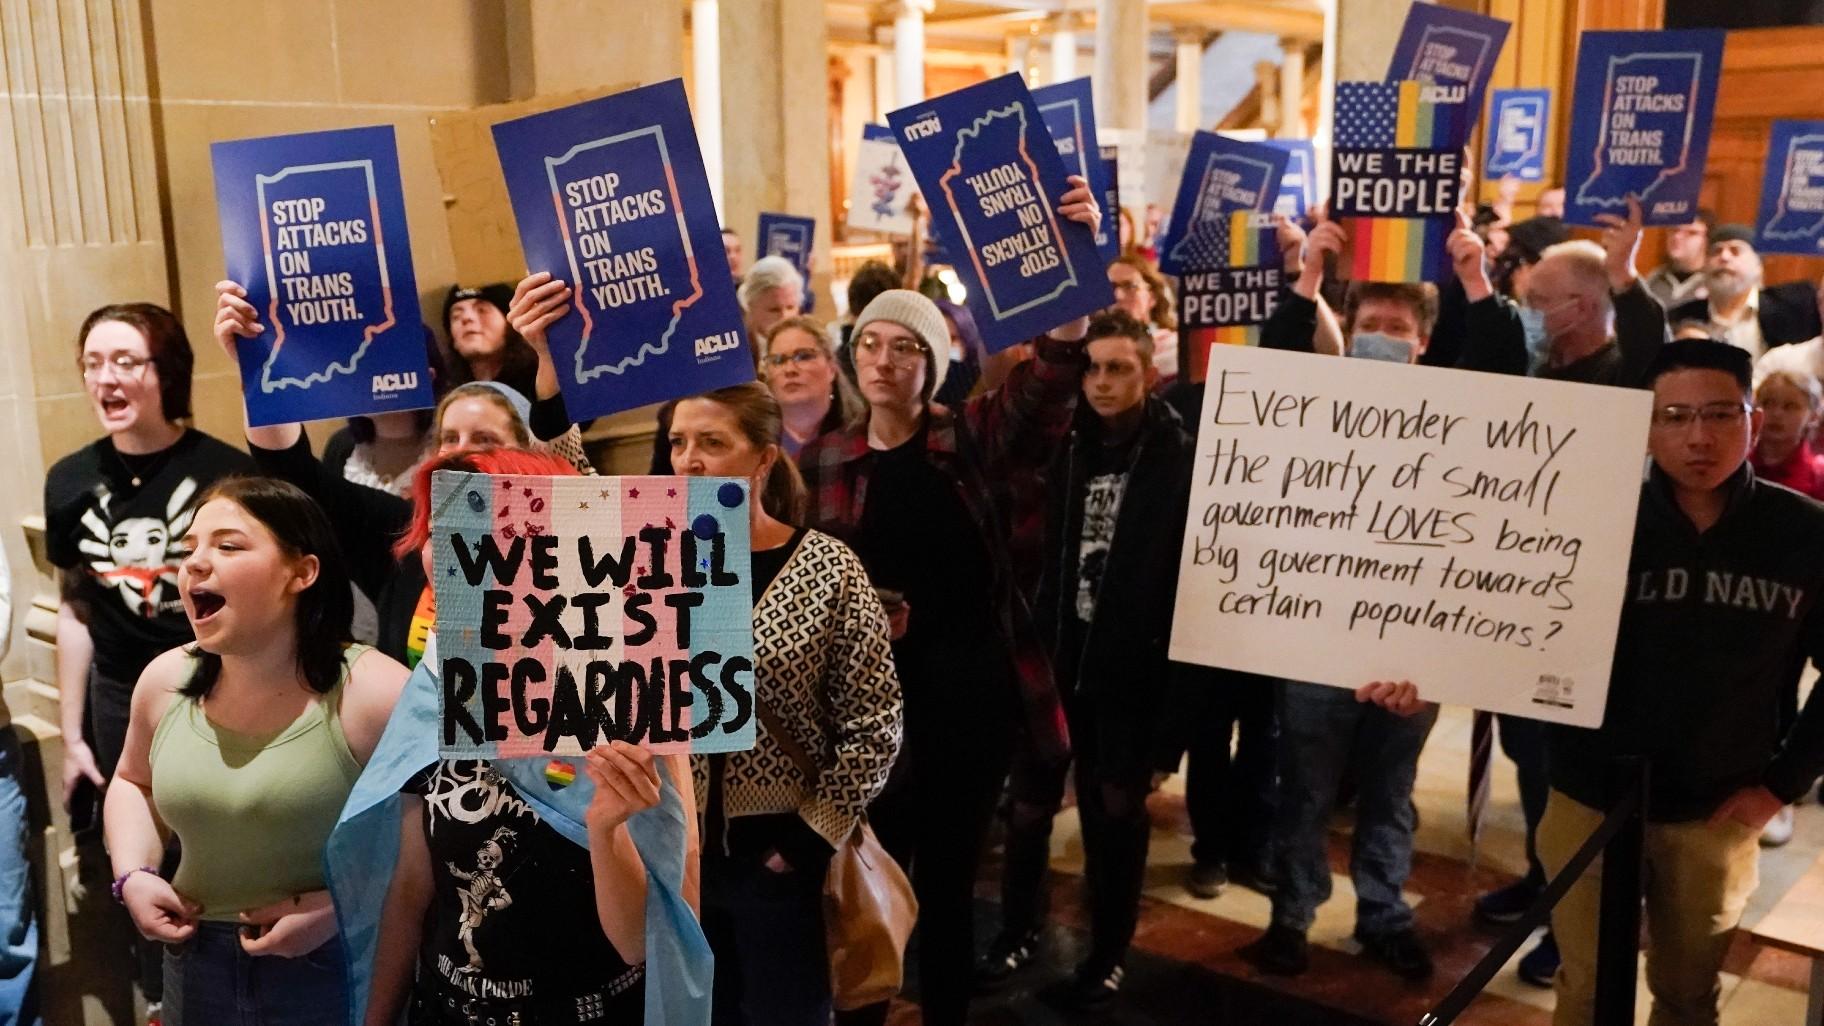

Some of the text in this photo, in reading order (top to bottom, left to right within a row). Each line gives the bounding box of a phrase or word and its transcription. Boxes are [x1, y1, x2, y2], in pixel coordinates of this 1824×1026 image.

[1420, 85, 1466, 103] ACLU
[1616, 76, 1658, 93] STOP
[1613, 94, 1684, 111] ATTACKS
[904, 116, 942, 142] ACLU
[1612, 112, 1635, 128] ON
[1609, 130, 1662, 147] TRANS
[1338, 153, 1456, 174] WE THE
[1608, 148, 1664, 165] YOUTH.
[565, 172, 620, 206] STOP
[965, 161, 1026, 197] YOUTH.
[273, 197, 325, 224] STOP
[979, 183, 1036, 218] TRANS
[1336, 178, 1454, 214] PEOPLE
[1652, 201, 1688, 214] ACLU
[574, 190, 666, 233] ATTACKS
[1016, 203, 1043, 229] ON
[277, 219, 367, 249] ATTACKS
[581, 231, 611, 260] ON
[981, 224, 1050, 267] ATTACKS
[280, 252, 310, 277] ON
[584, 247, 658, 284] TRANS
[1020, 246, 1060, 277] STOP
[282, 273, 353, 299] TRANS
[591, 273, 670, 311] YOUTH.
[1185, 269, 1279, 291] WE THE
[287, 299, 363, 326] YOUTH.
[694, 330, 740, 357] ACLU
[372, 372, 418, 393] ACLU
[1214, 369, 1577, 470] Ever wonder why
[1206, 437, 1269, 487] the
[1282, 449, 1376, 503] party
[1392, 452, 1435, 489] of
[1203, 499, 1582, 579] government LOVES being
[451, 527, 739, 590] WE WILL
[1193, 535, 1574, 610] big government towards
[1637, 569, 1804, 619] LD NAVY
[480, 589, 704, 650] EXIST
[1218, 587, 1563, 652] certain populations?
[443, 651, 753, 752] REGARDLESS
[482, 978, 533, 999] PARADE
